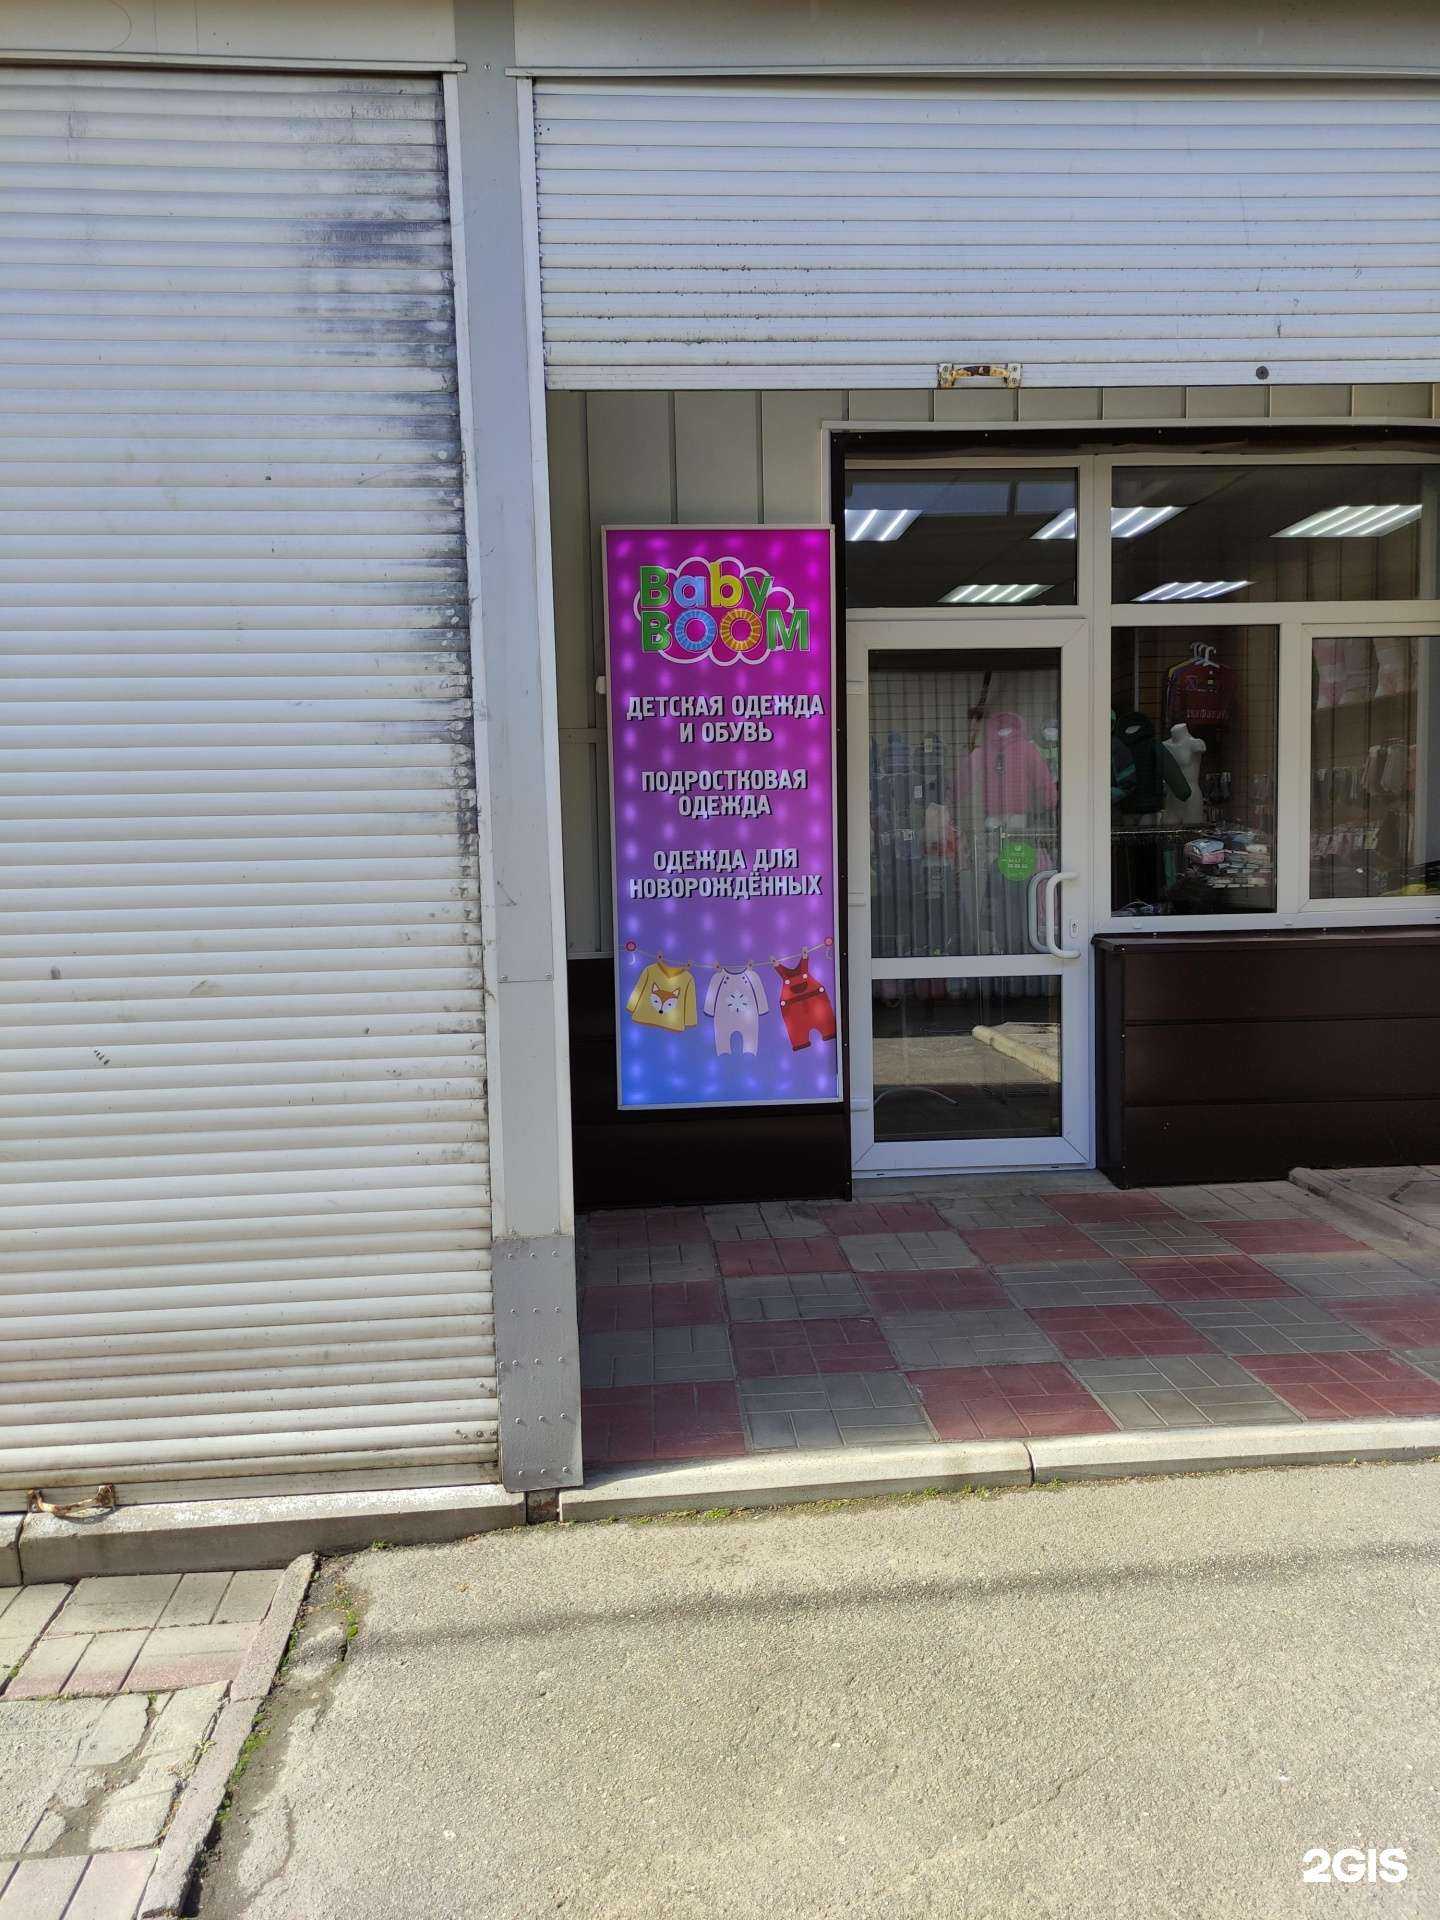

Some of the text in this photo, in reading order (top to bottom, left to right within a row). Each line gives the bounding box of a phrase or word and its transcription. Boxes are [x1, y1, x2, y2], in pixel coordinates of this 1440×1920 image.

[639, 561, 774, 617] Baby
[641, 609, 811, 653] BOOM
[627, 695, 825, 721] ДЕТСКАЯ ОДЕЖДА
[679, 721, 773, 743] И ОБУВЬ
[641, 769, 808, 794] ПОДРОСТКОВАЯ
[678, 795, 772, 819] ОДЕЖДА
[653, 848, 799, 873] ОДЕЖДА ДЛЯ
[629, 872, 823, 899] НОВОРОЖДЁННЫХ
